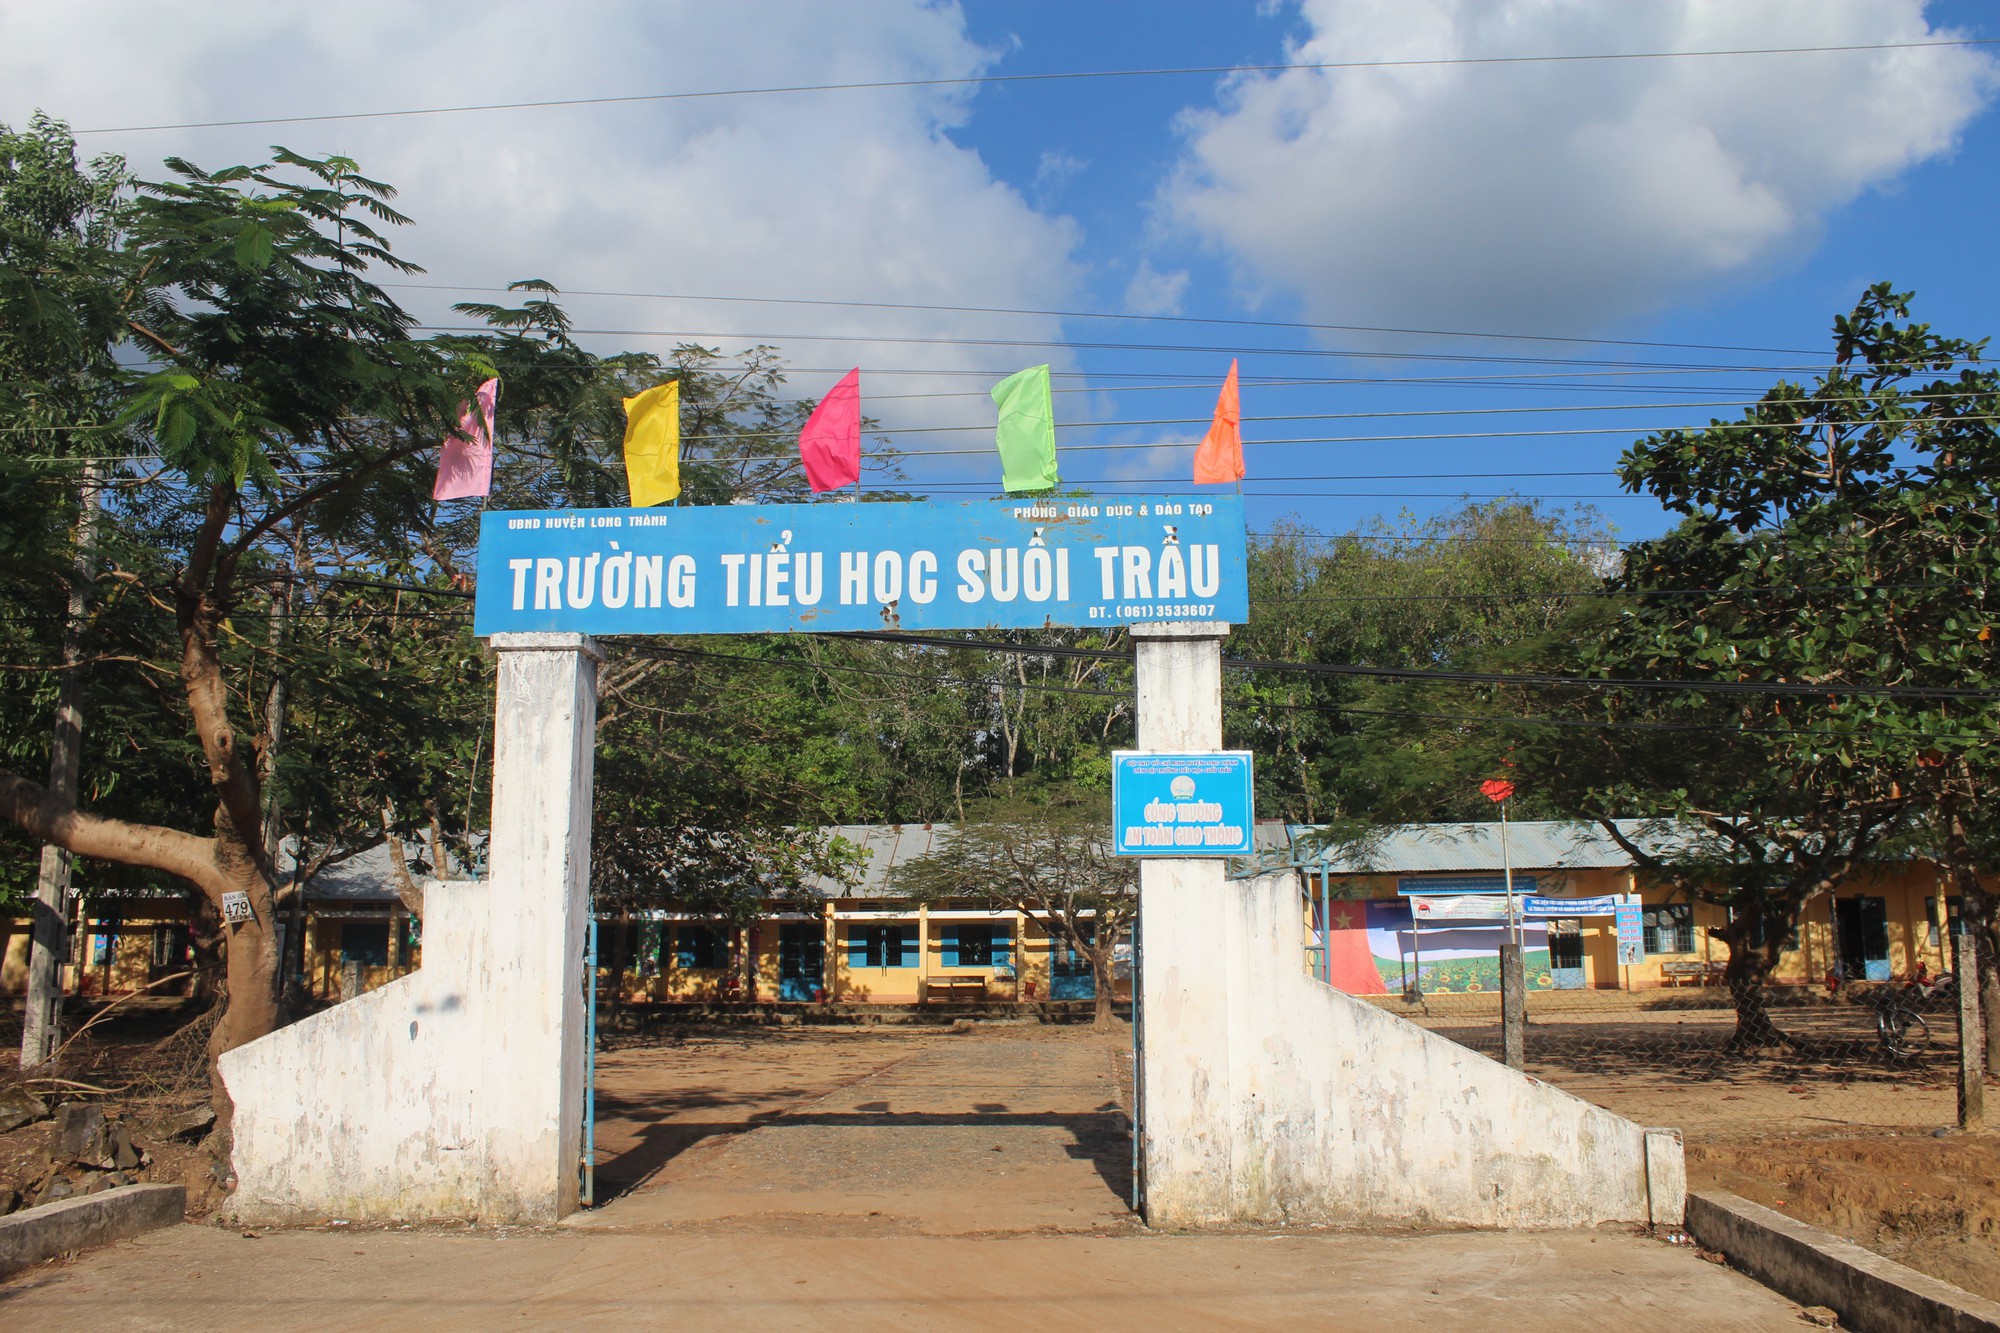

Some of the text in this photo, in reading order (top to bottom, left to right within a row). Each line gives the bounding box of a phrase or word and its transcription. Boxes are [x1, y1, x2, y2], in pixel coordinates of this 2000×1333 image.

[1014, 502, 1213, 519] PHÒNG GIÁO DỤC & ĐÀO TẠO
[509, 514, 667, 530] UBND HUYỆN LONG THÀNH
[509, 525, 1219, 615] TRƯỜNG TIỂU HỌC SUỐI TRẦU
[1089, 606, 1112, 618] ĐT.
[1124, 826, 1142, 846] AN
[1174, 826, 1203, 846] GIAO
[225, 901, 248, 916] 479
